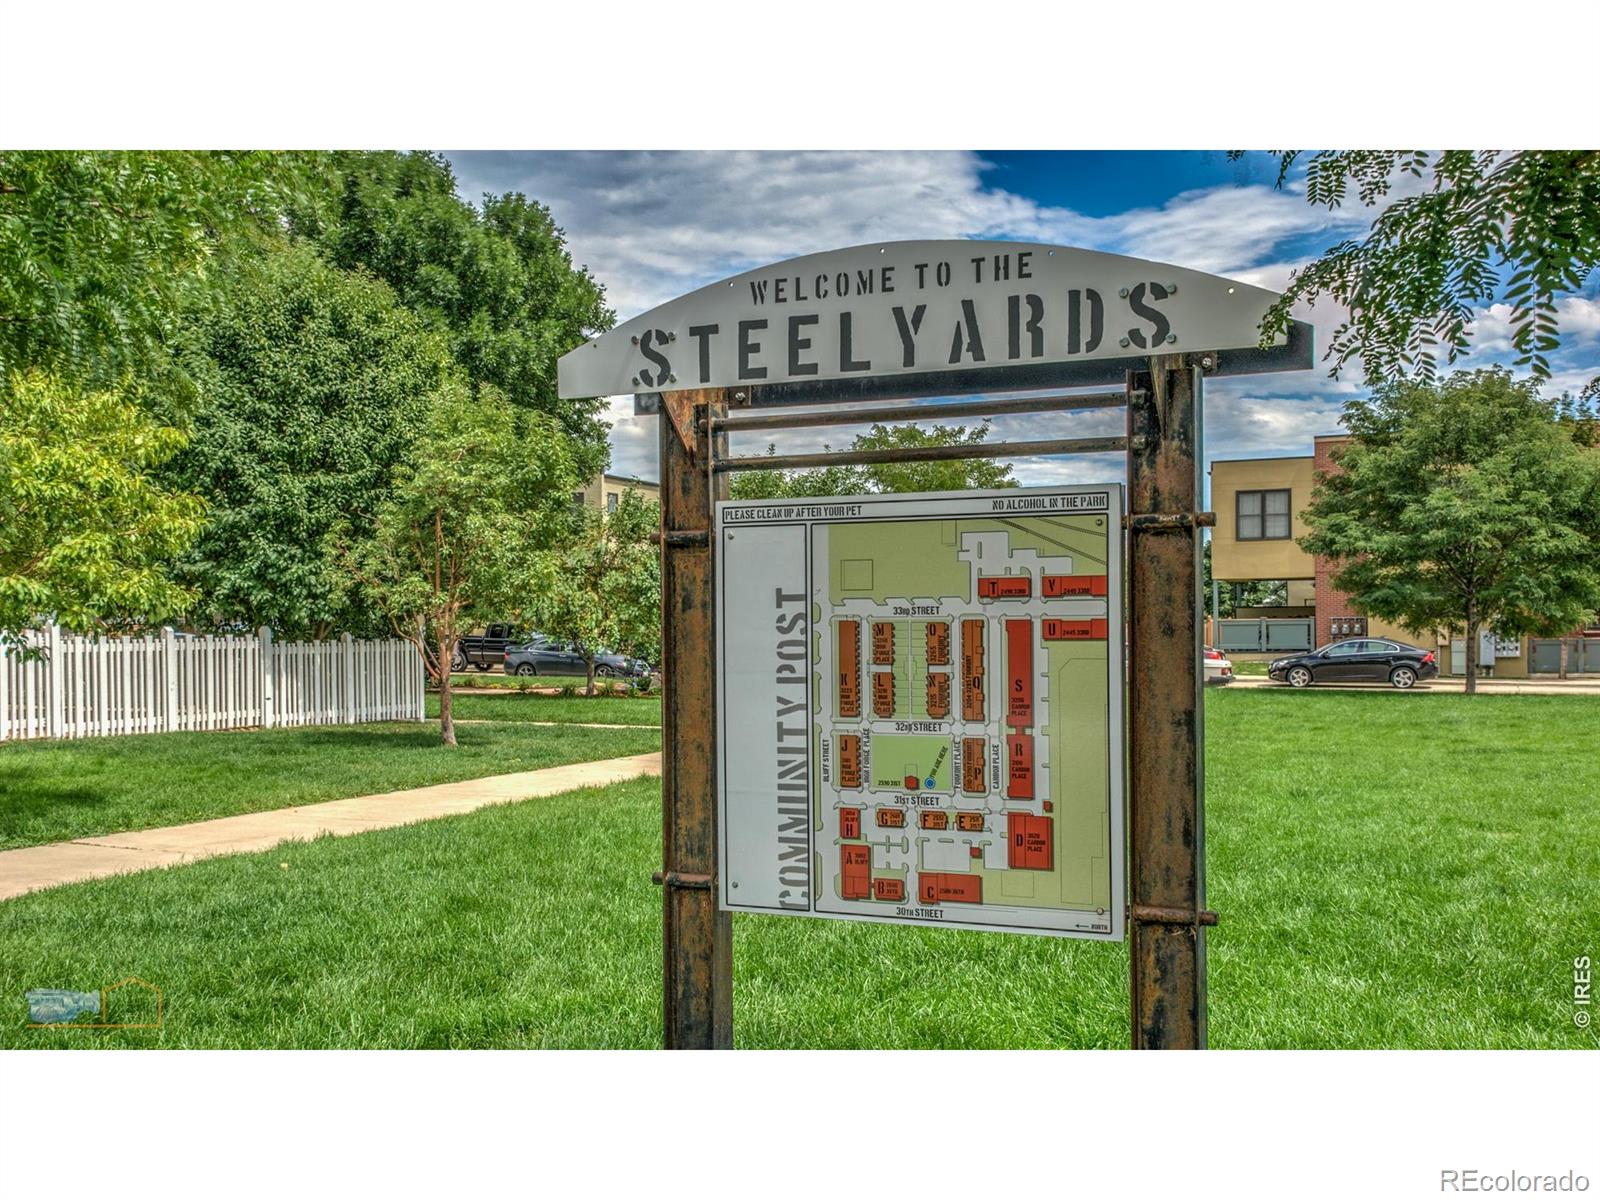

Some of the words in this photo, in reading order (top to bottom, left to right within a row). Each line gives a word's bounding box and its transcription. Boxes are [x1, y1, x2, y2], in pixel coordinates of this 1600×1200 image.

[750, 266, 896, 305] WELCOME
[914, 261, 951, 289] TO
[971, 252, 1033, 284] THE
[638, 281, 1171, 387] STEELYARDS
[992, 500, 1005, 511] NO
[1006, 498, 1048, 511] ALCOHOL
[1049, 497, 1059, 509] IN
[1061, 496, 1079, 509] THE
[1080, 495, 1107, 508] PARK
[725, 509, 755, 521] PLEASE
[756, 508, 783, 520] CLEAN
[784, 507, 795, 519] UP
[795, 506, 823, 518] AFTER
[823, 506, 846, 518] YOUR
[846, 505, 863, 517] PET
[990, 581, 997, 595] T
[1048, 579, 1056, 592] V
[911, 606, 940, 615] STREET
[775, 587, 808, 685] POST
[1048, 623, 1056, 636] U
[841, 673, 848, 686] K
[878, 674, 884, 687] L
[1015, 679, 1023, 692] S
[913, 722, 943, 732] STREET
[822, 739, 830, 762] STREET
[841, 739, 848, 751] J
[1015, 743, 1023, 757] R
[992, 744, 1000, 764] PLACE
[974, 767, 981, 780] P
[776, 695, 810, 909] COMMUNITY
[894, 795, 909, 805] 31ST
[910, 796, 940, 806] STREET
[923, 814, 929, 827] F
[960, 816, 966, 828] E
[846, 823, 853, 836] H
[1016, 833, 1023, 847] D
[846, 851, 853, 865] A
[878, 882, 885, 894] B
[927, 886, 934, 899] C
[896, 907, 914, 917] 30TH
[915, 908, 944, 919] STREET
